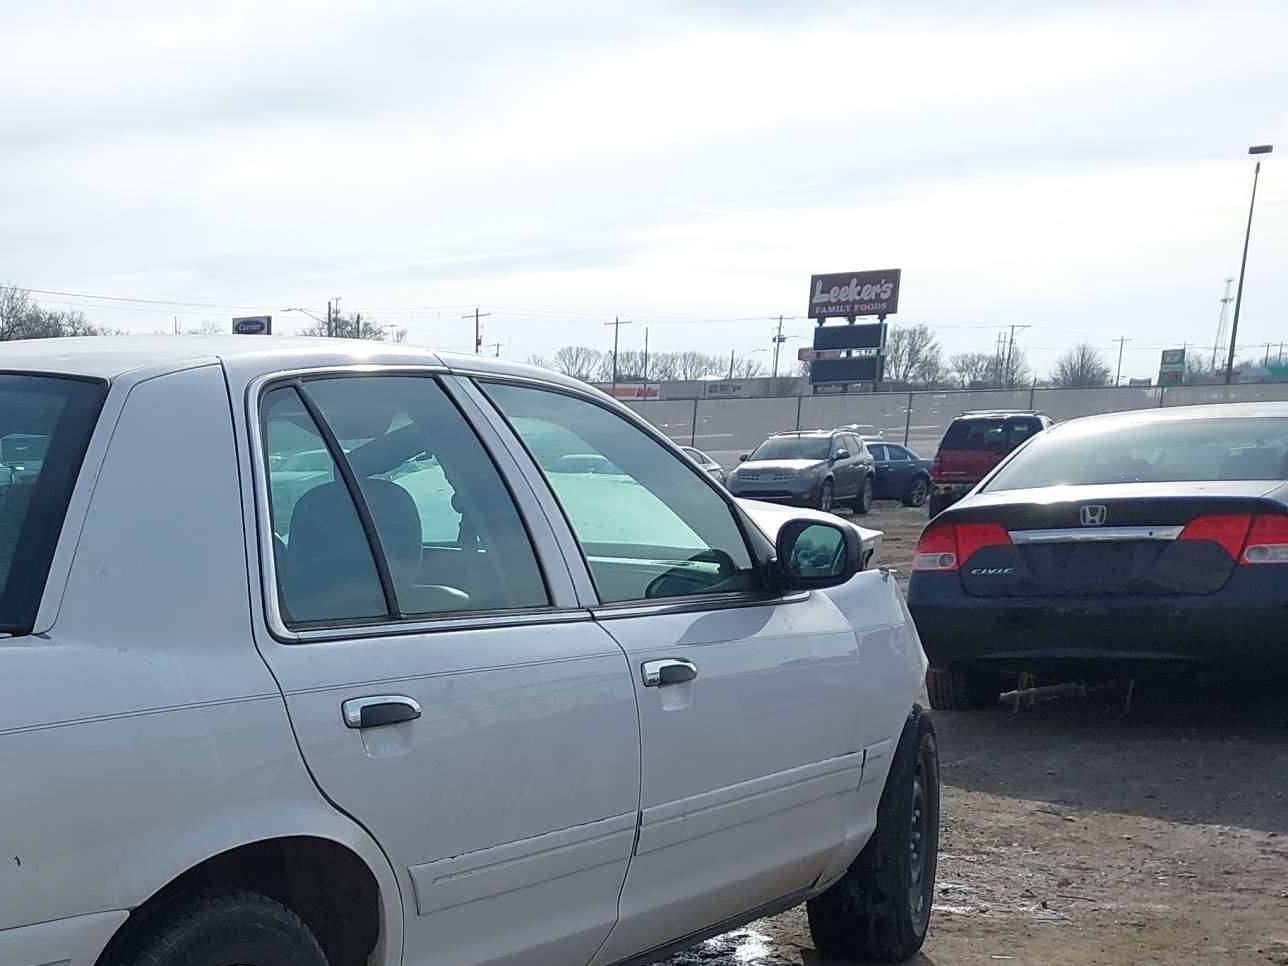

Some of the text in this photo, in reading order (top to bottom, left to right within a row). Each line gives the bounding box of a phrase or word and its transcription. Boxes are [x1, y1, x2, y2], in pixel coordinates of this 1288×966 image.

[812, 277, 894, 304] Leeker's
[815, 302, 887, 314] FAMILY FOODS
[971, 567, 1015, 575] CIVIC
